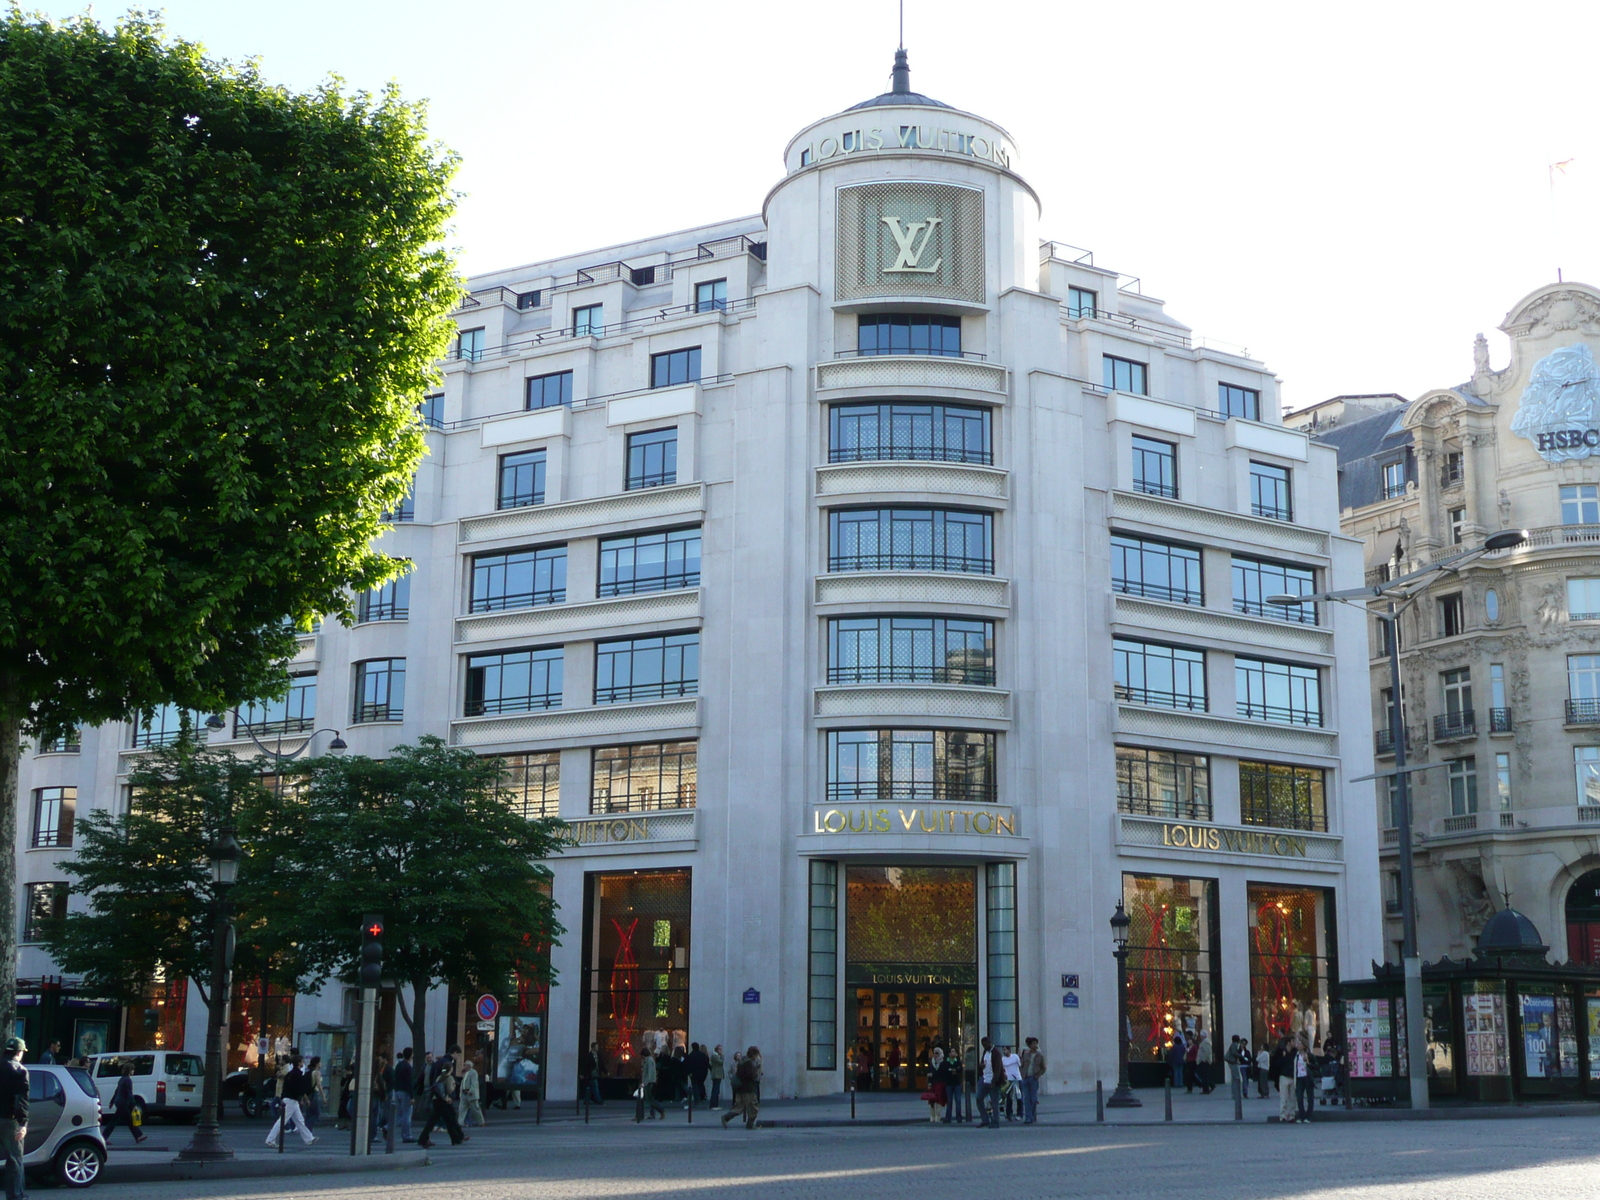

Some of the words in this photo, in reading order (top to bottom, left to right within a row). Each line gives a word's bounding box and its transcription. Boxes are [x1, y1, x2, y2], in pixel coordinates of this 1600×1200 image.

[808, 127, 883, 163] LOUIS
[893, 126, 1008, 168] VUITTON
[1537, 429, 1600, 451] HSBC
[552, 819, 648, 843] VUITTON
[814, 809, 891, 833] LOUIS
[898, 809, 1015, 836] VUITTON
[1163, 824, 1220, 850] LOUIS
[1223, 830, 1306, 857] VUITTON
[873, 974, 903, 985] LOUIS
[904, 974, 951, 985] VUITTON
[1527, 1039, 1546, 1053] 100
